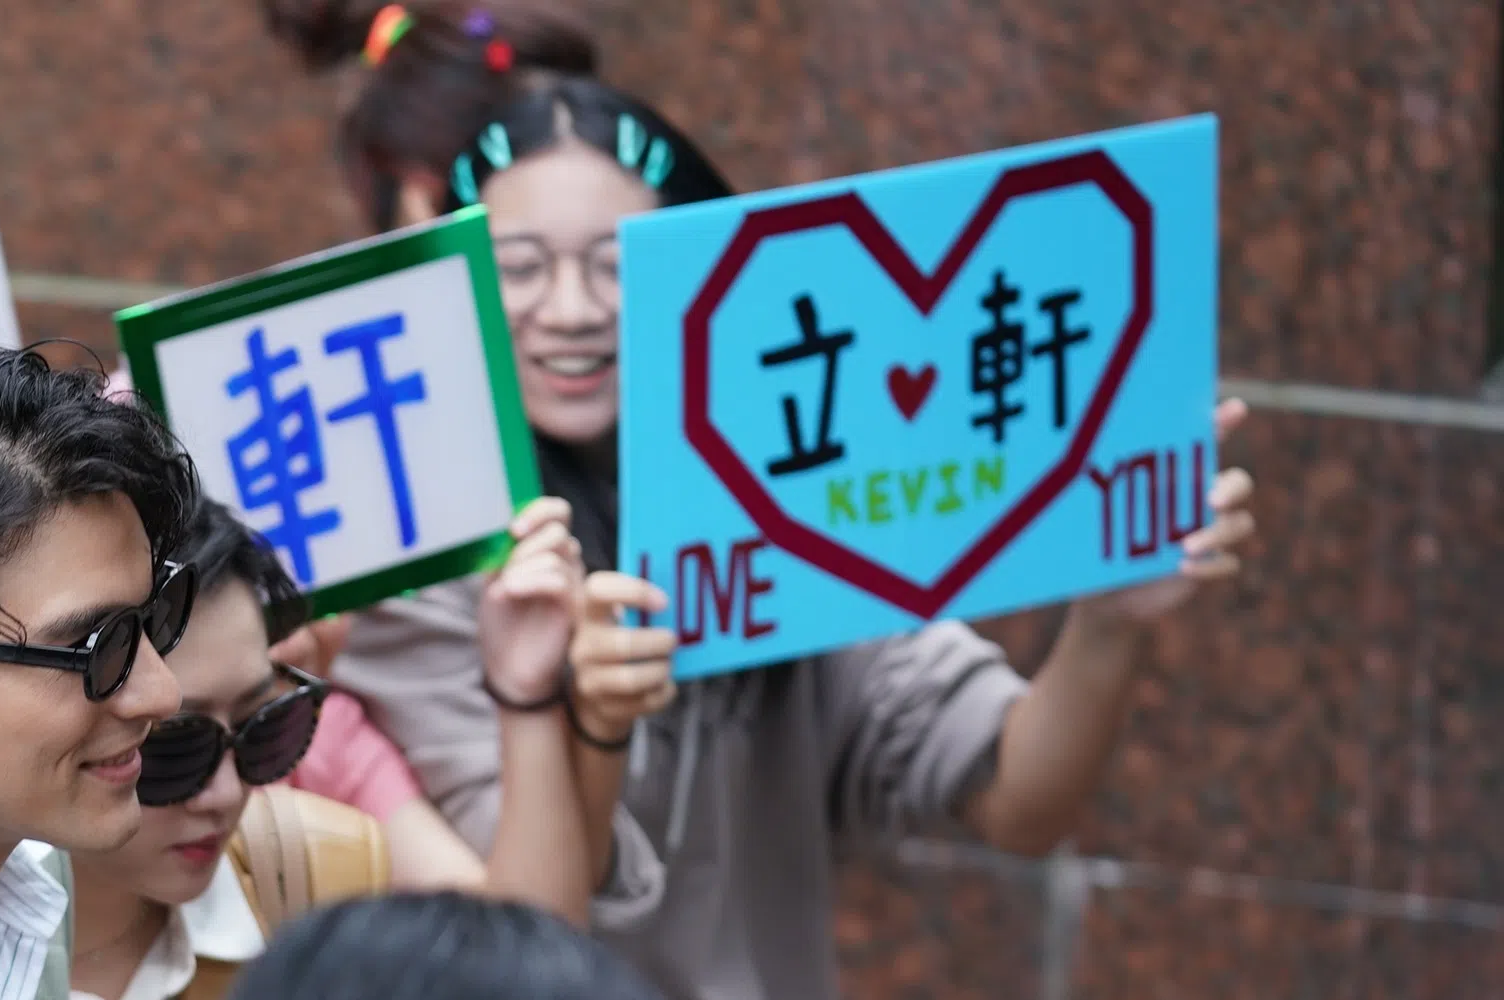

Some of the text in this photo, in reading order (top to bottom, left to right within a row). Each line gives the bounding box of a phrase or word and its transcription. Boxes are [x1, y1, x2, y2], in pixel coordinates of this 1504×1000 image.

[225, 312, 427, 586] 軒
[759, 268, 1092, 477] 立 軒
[826, 455, 1005, 528] KEVIN
[1086, 441, 1205, 562] YOU
